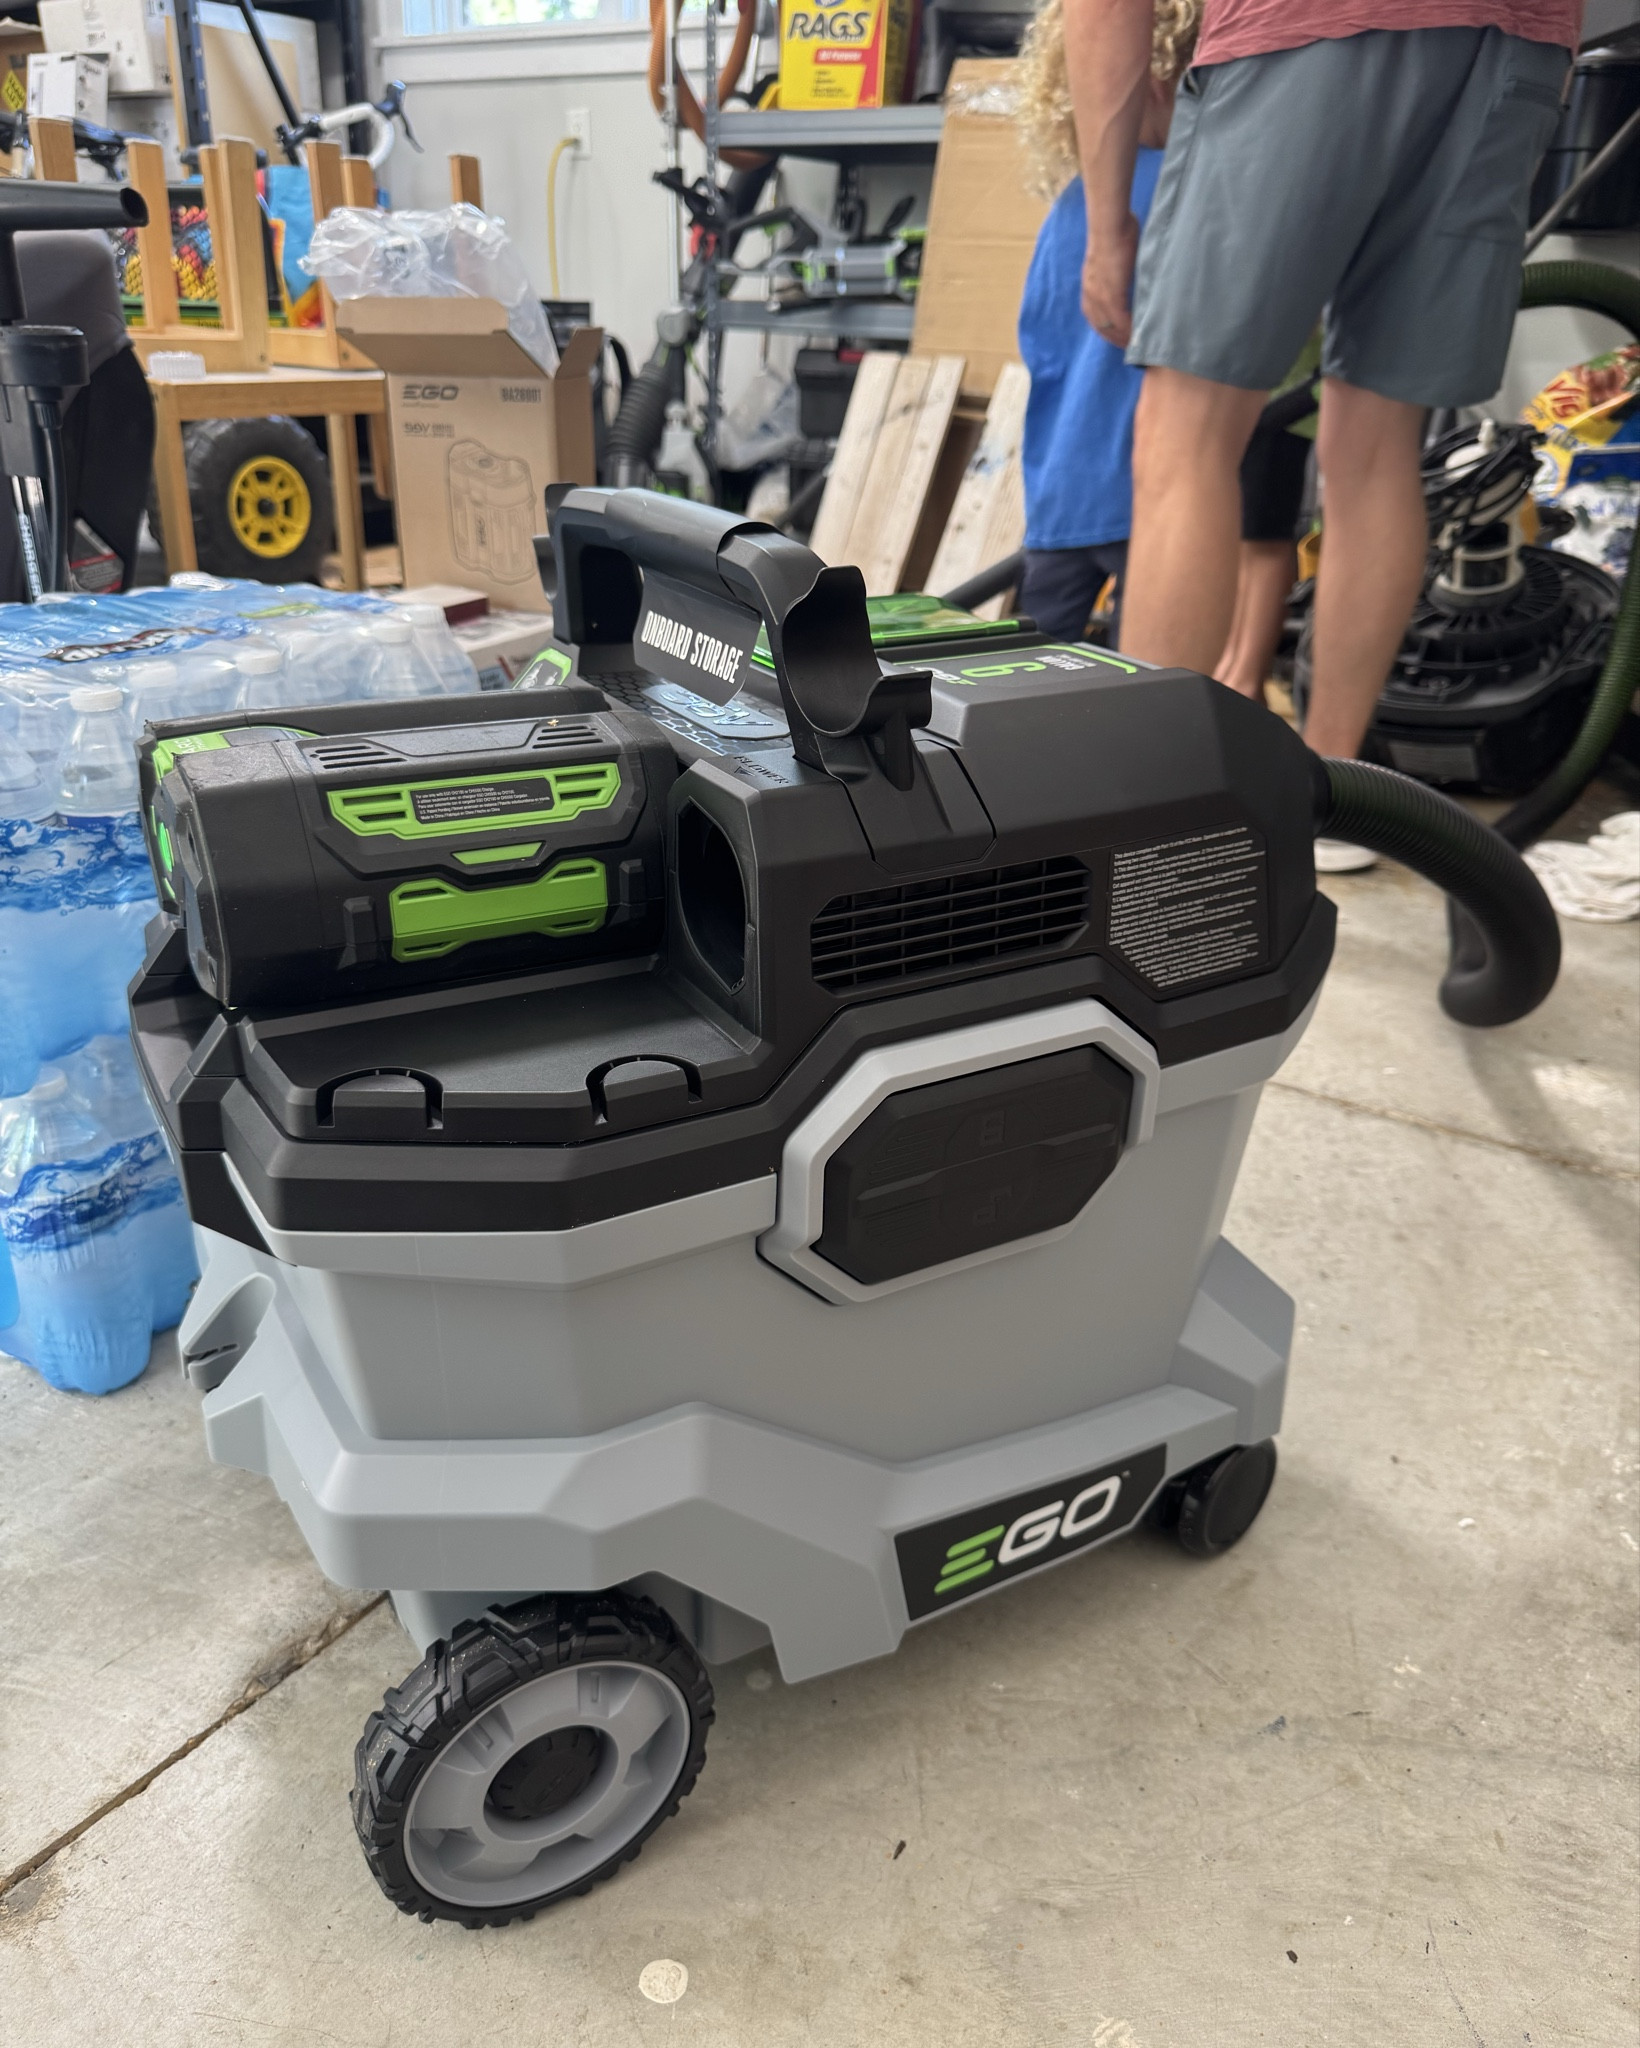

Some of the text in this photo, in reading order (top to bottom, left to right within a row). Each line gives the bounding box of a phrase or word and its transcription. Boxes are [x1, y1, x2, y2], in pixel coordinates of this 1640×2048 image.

[788, 12, 871, 39] RAGS
[403, 384, 459, 401] EGO
[641, 610, 744, 684] ONBOARD STORAGE
[733, 755, 789, 785] BLOWER
[934, 1475, 1122, 1594] EGO
